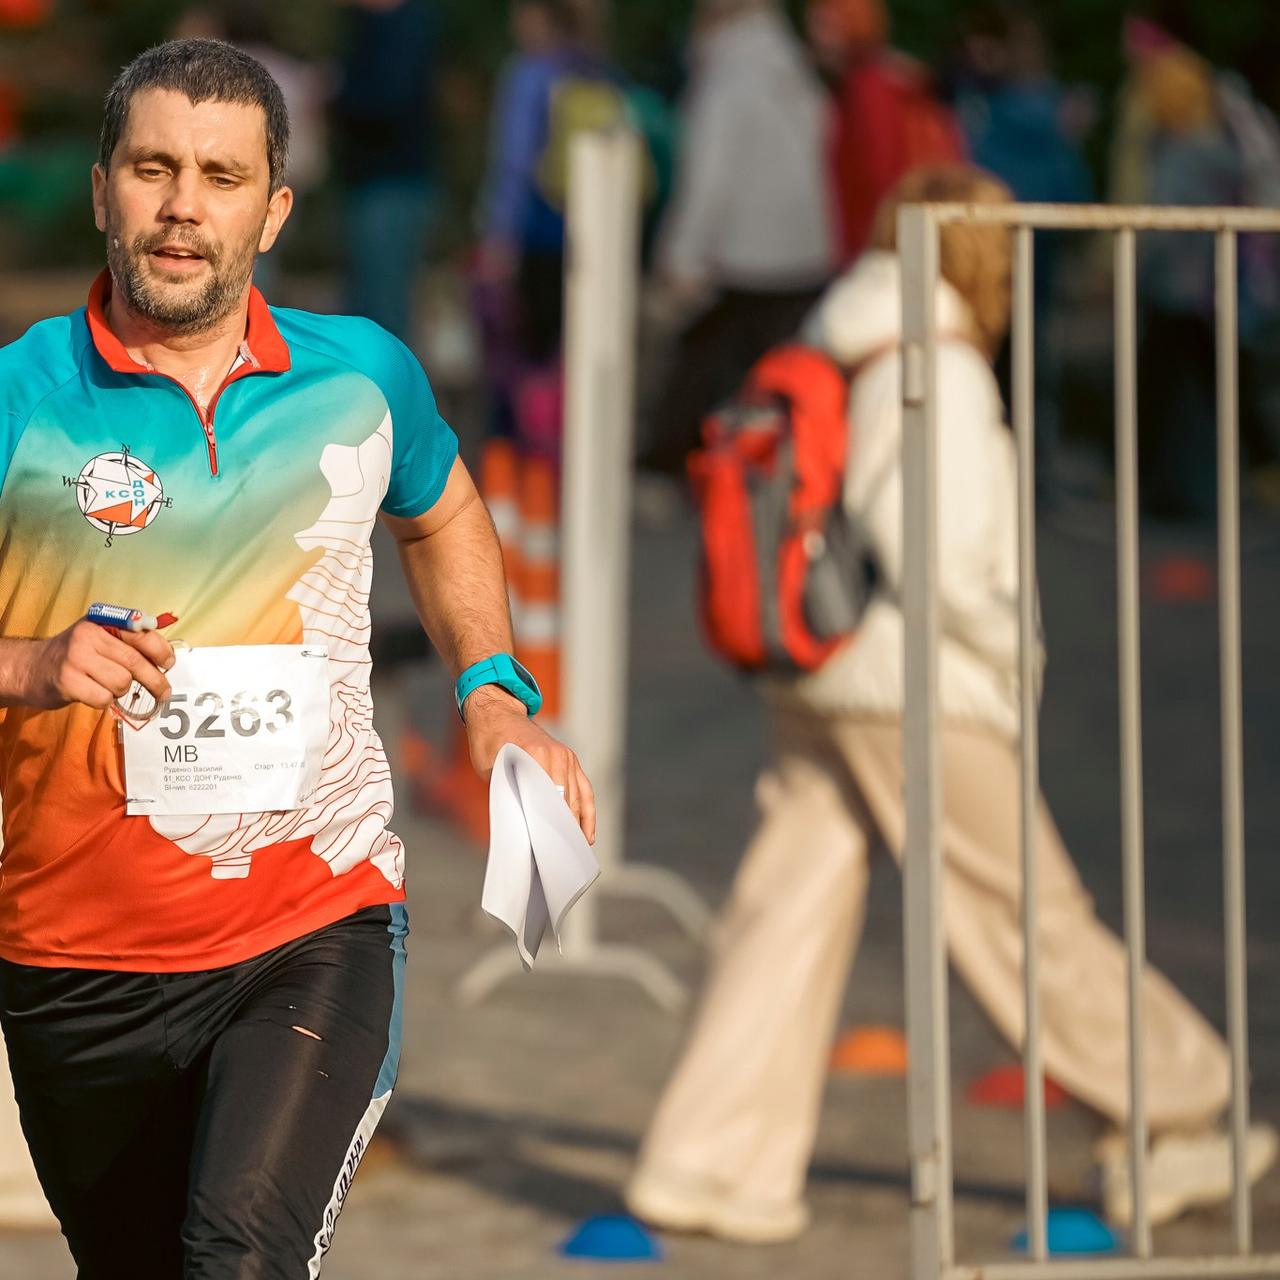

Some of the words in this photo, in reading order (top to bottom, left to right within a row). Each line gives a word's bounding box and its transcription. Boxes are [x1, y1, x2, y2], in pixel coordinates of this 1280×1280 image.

[121, 443, 131, 454] N
[62, 475, 75, 487] W
[165, 497, 173, 508] E
[104, 536, 114, 548] S
[159, 689, 294, 740] 5263
[193, 765, 223, 773] Василий
